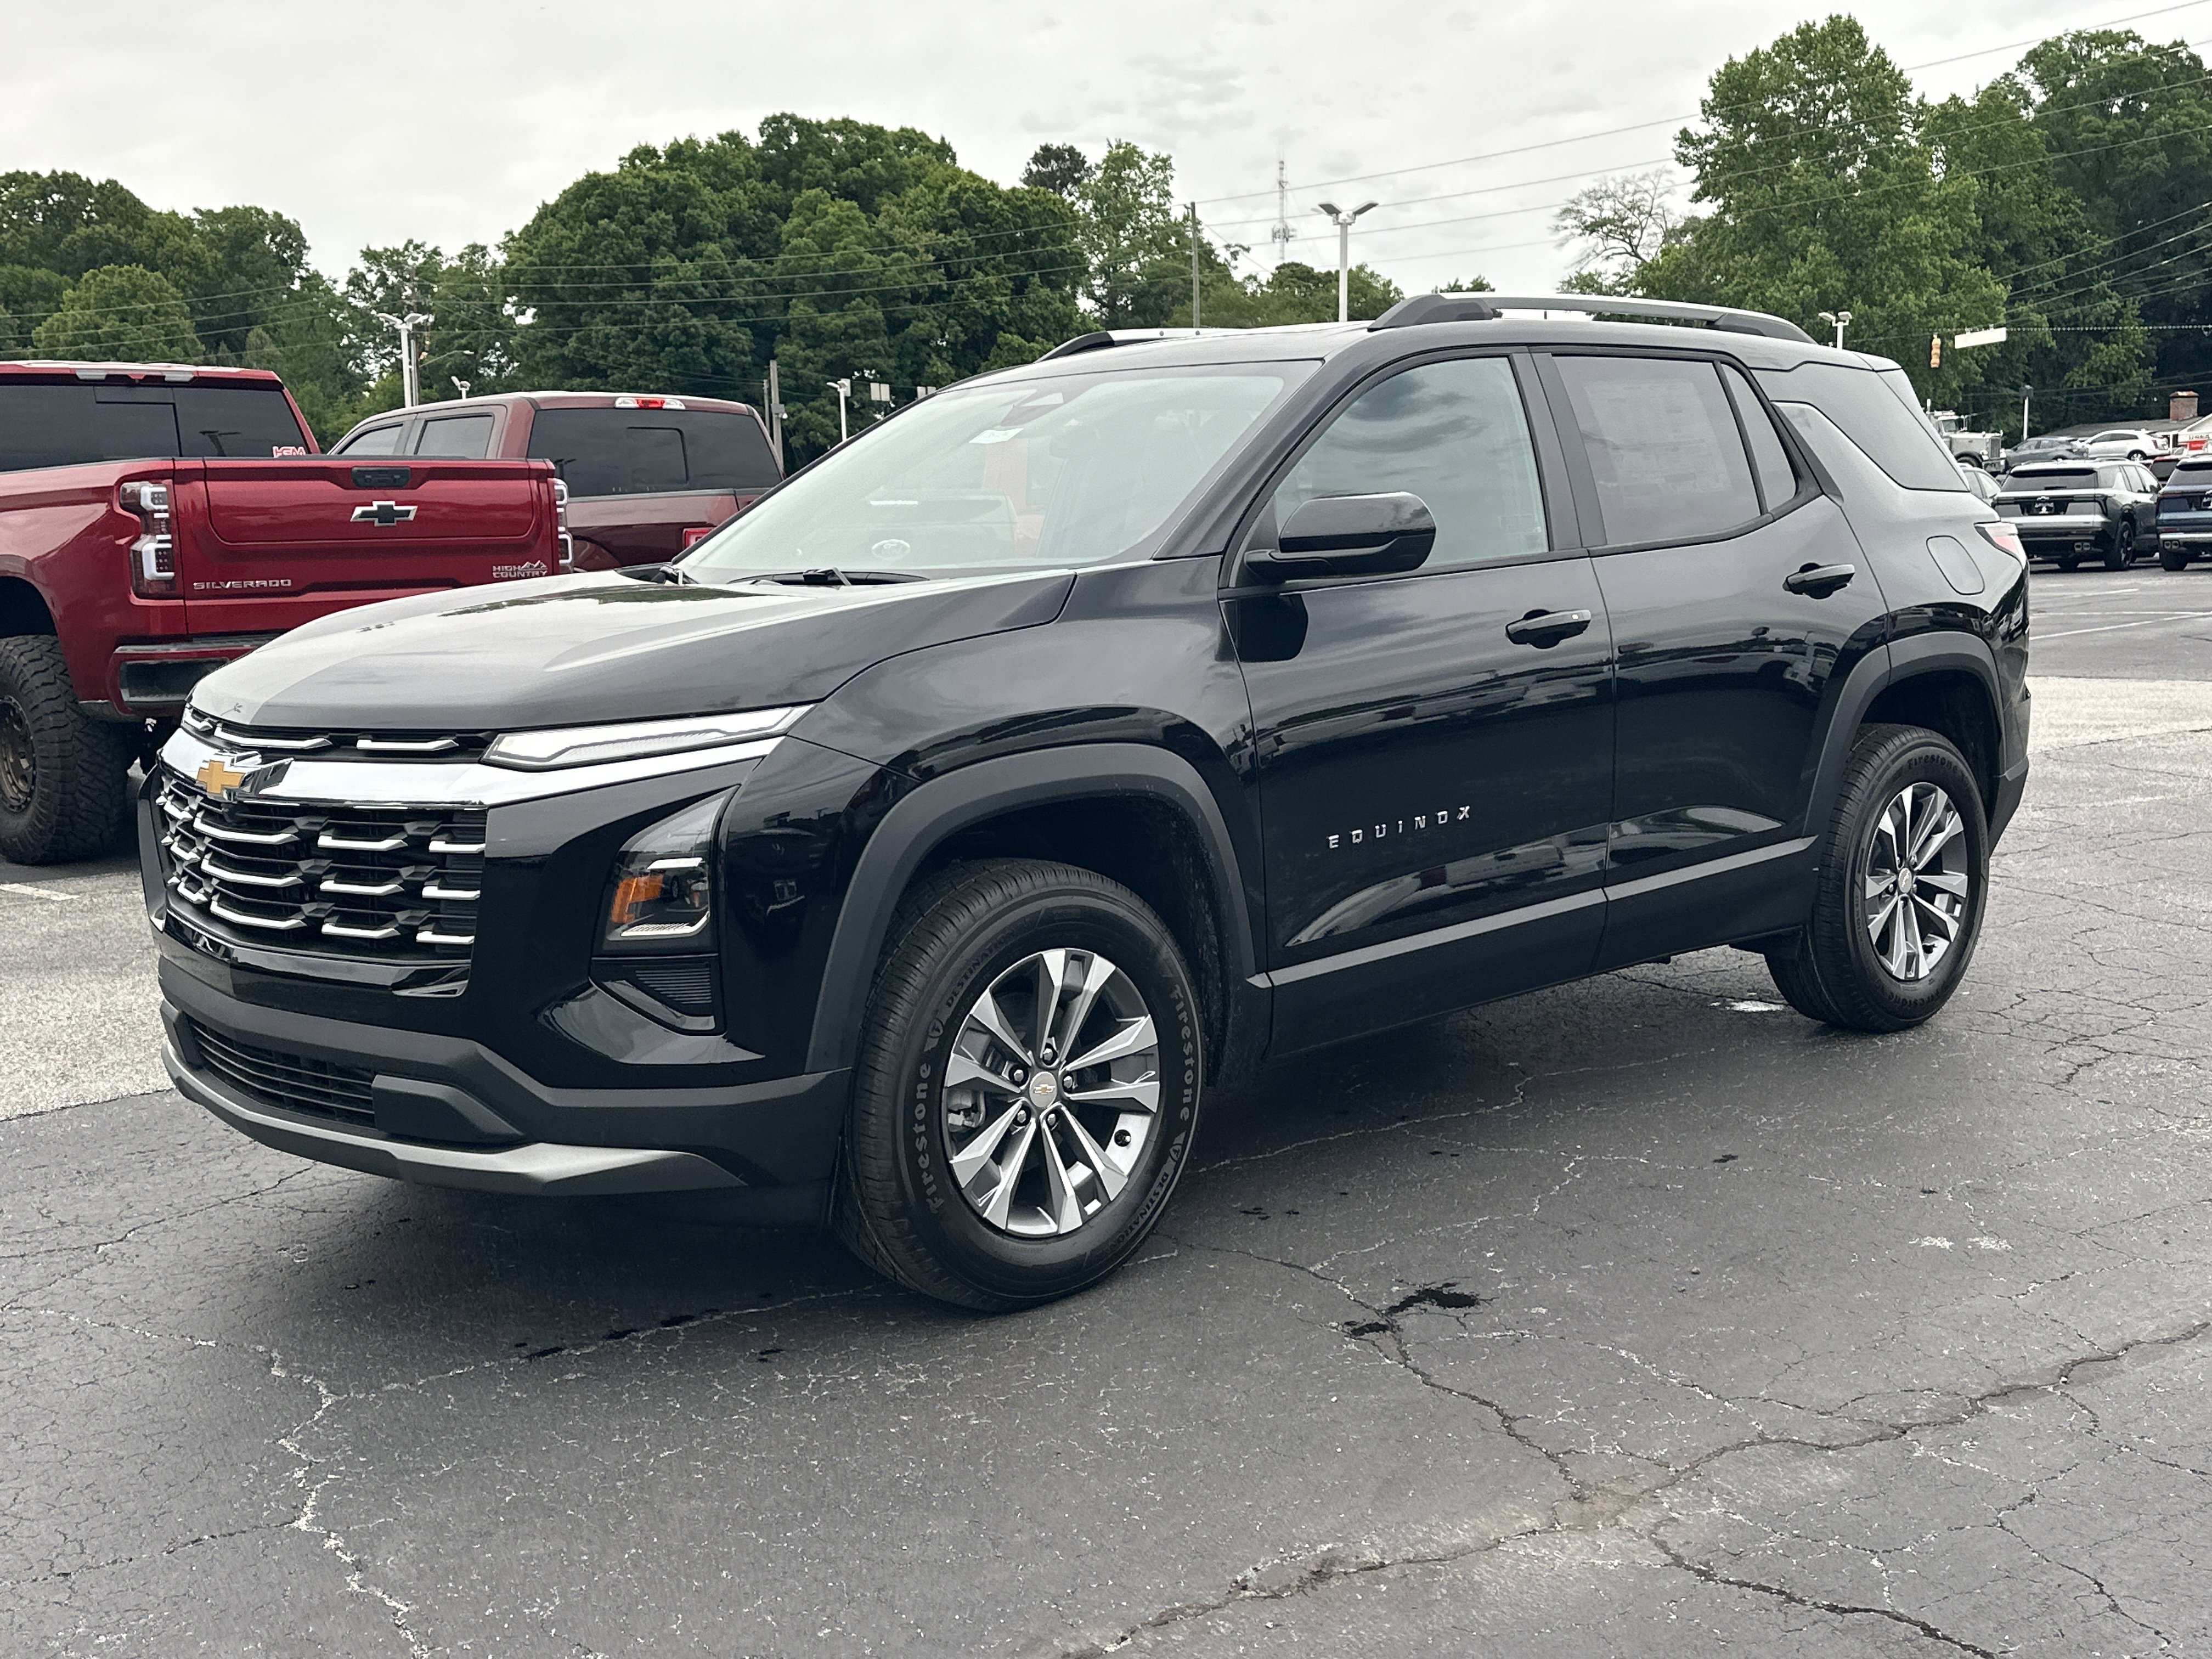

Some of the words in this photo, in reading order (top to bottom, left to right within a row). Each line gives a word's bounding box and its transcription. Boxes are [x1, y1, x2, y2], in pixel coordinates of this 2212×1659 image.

[193, 579, 291, 590] SILVERADO
[493, 571, 548, 579] COUNTRY
[1907, 754, 1959, 775] Firestone
[1326, 805, 1471, 849] EQUINOX
[1169, 984, 1195, 1122] Firestone
[912, 1063, 944, 1214] Firestone
